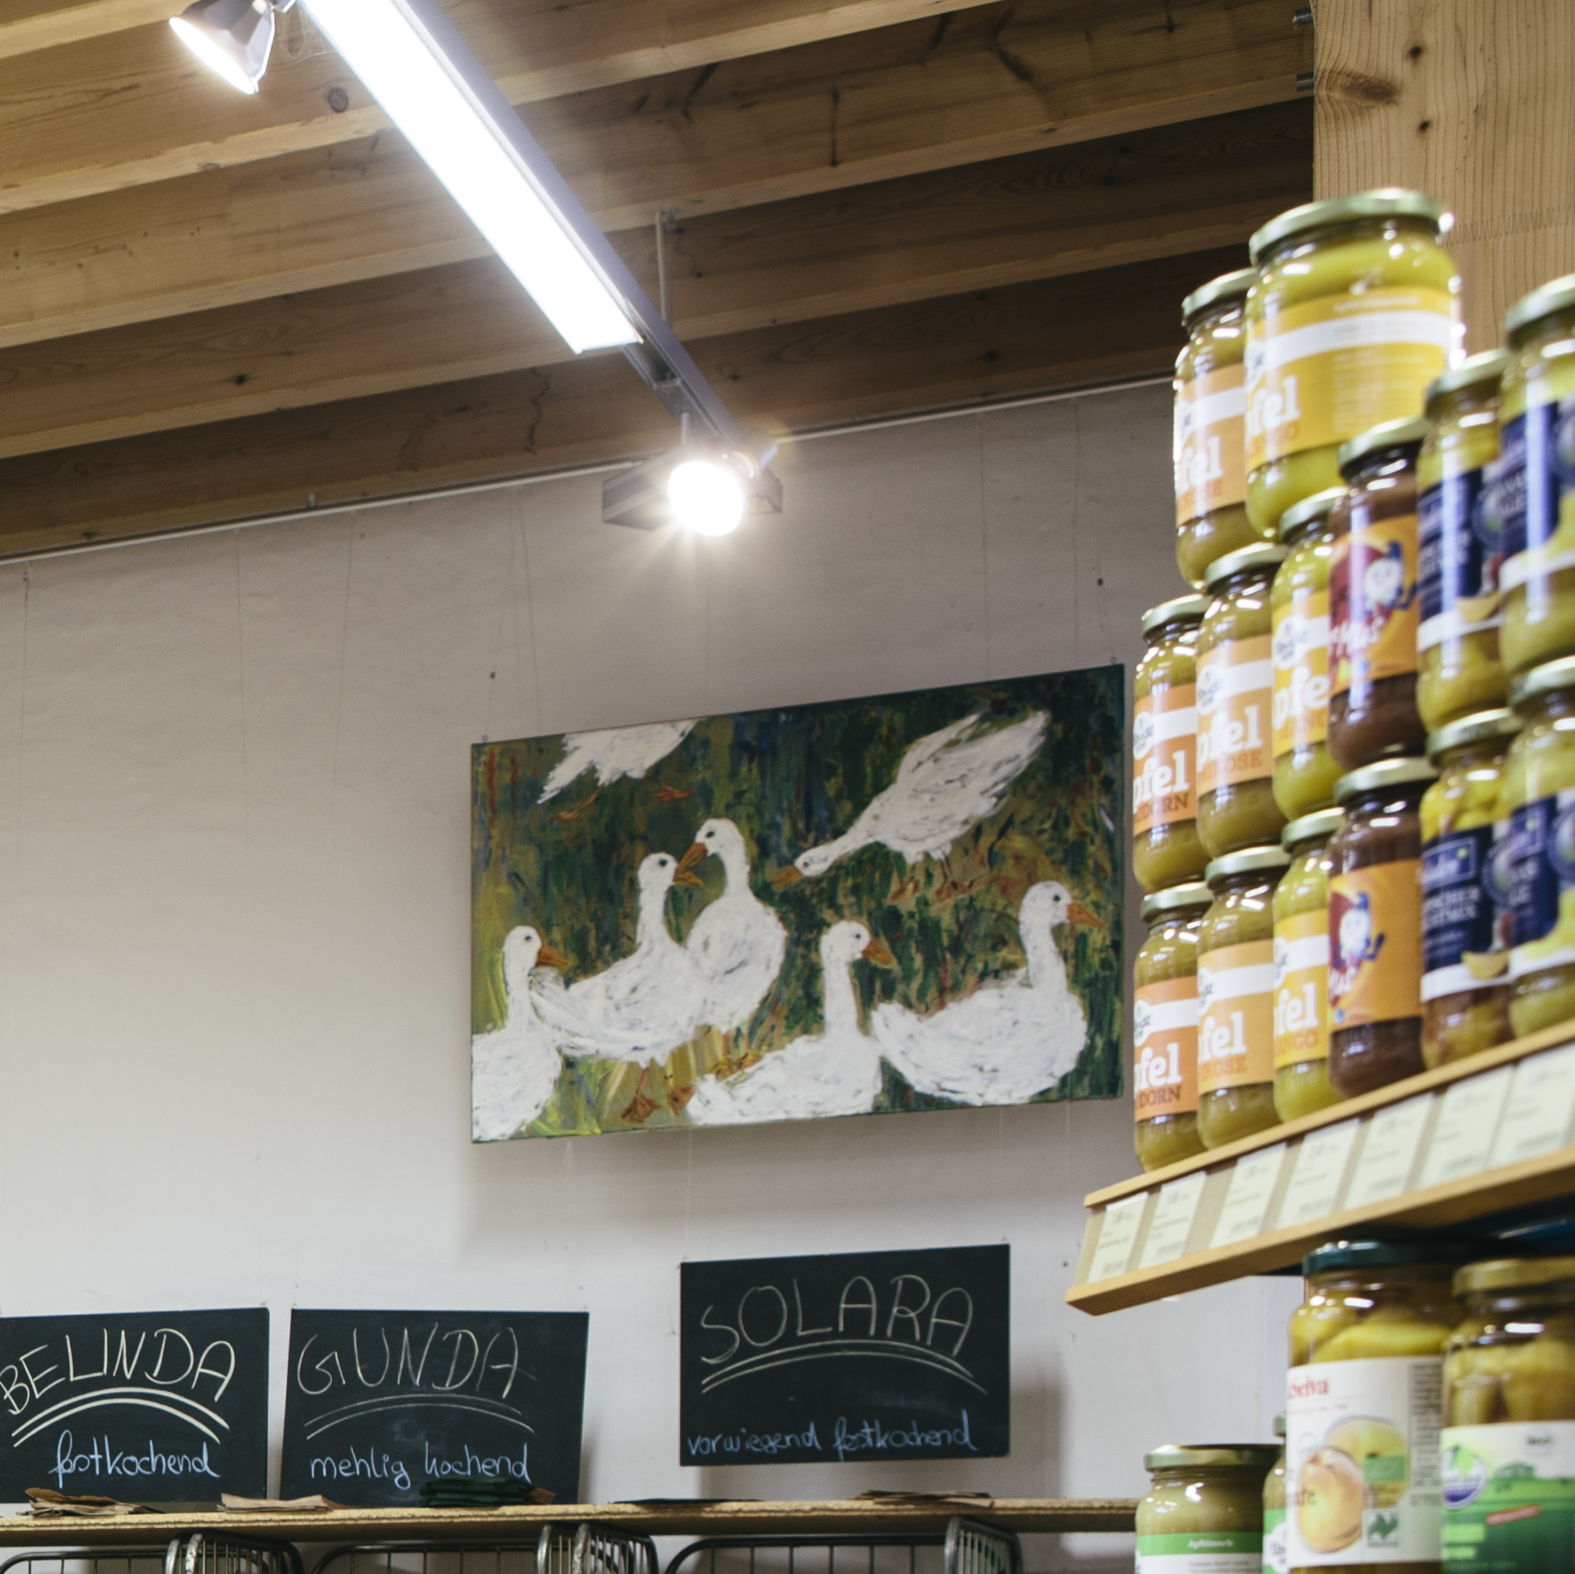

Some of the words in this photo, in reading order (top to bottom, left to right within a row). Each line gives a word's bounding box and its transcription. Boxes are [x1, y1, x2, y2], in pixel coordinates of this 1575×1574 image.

[1197, 705, 1263, 773] pfel
[700, 1274, 974, 1366] SOLARA
[297, 1322, 531, 1399] GUNDA
[49, 1429, 221, 1490] festkochend
[687, 1422, 823, 1457] vorwiegend
[834, 1409, 978, 1454] festkochend
[310, 1445, 411, 1490] mehlig
[422, 1441, 532, 1484] kochend
